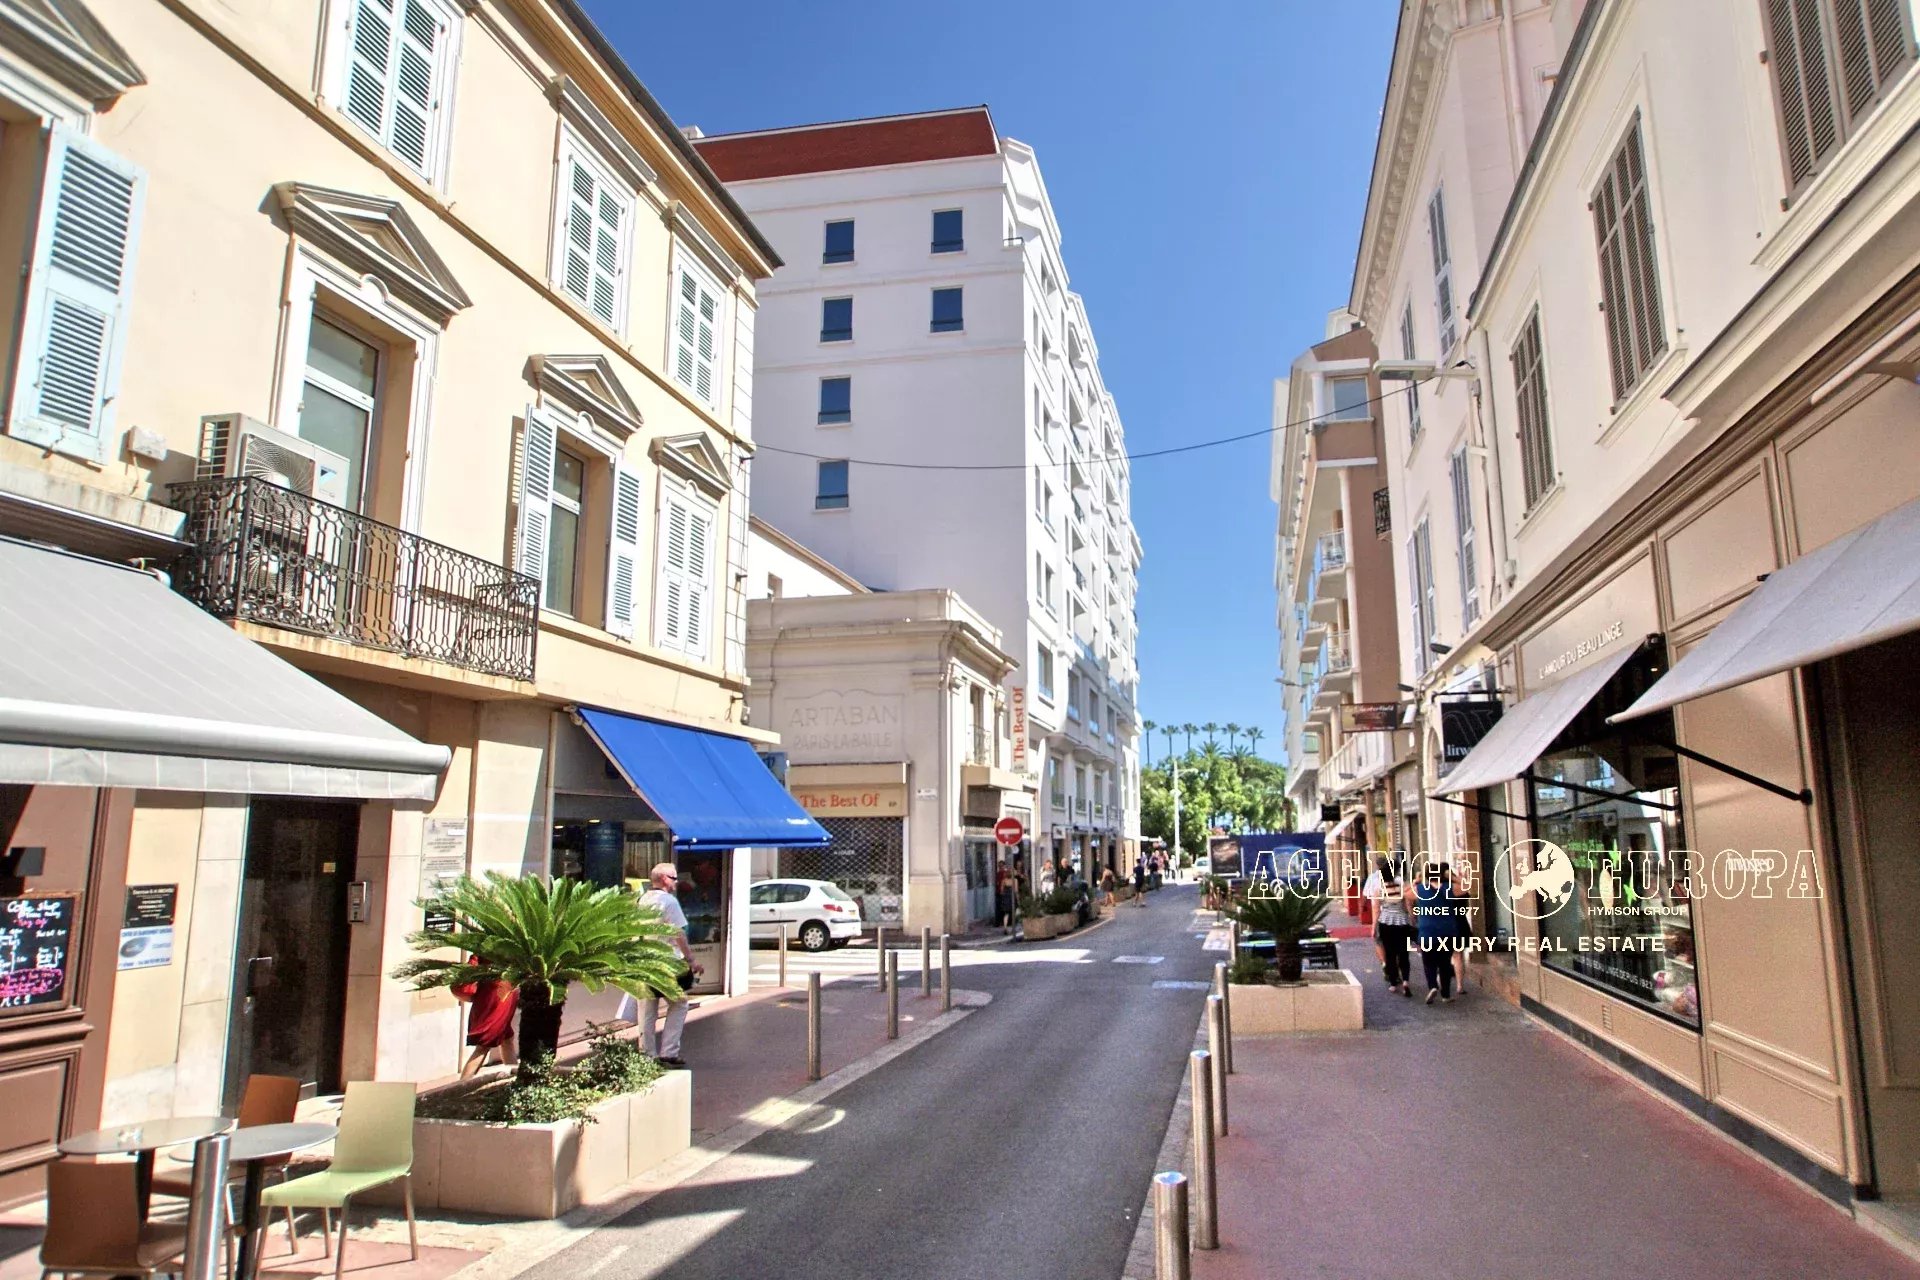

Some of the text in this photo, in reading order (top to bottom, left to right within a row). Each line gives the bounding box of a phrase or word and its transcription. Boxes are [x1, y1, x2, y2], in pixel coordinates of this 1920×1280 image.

[1566, 648, 1578, 665] DU
[1577, 636, 1599, 659] BEAU
[1598, 621, 1623, 648] LINGE
[1012, 686, 1025, 704] Of
[789, 704, 898, 727] ARTABAN
[1012, 707, 1025, 733] Best
[793, 733, 831, 750] PARIS
[1012, 737, 1025, 762] The
[799, 794, 826, 809] The
[830, 793, 858, 808] Best
[861, 793, 881, 808] Of
